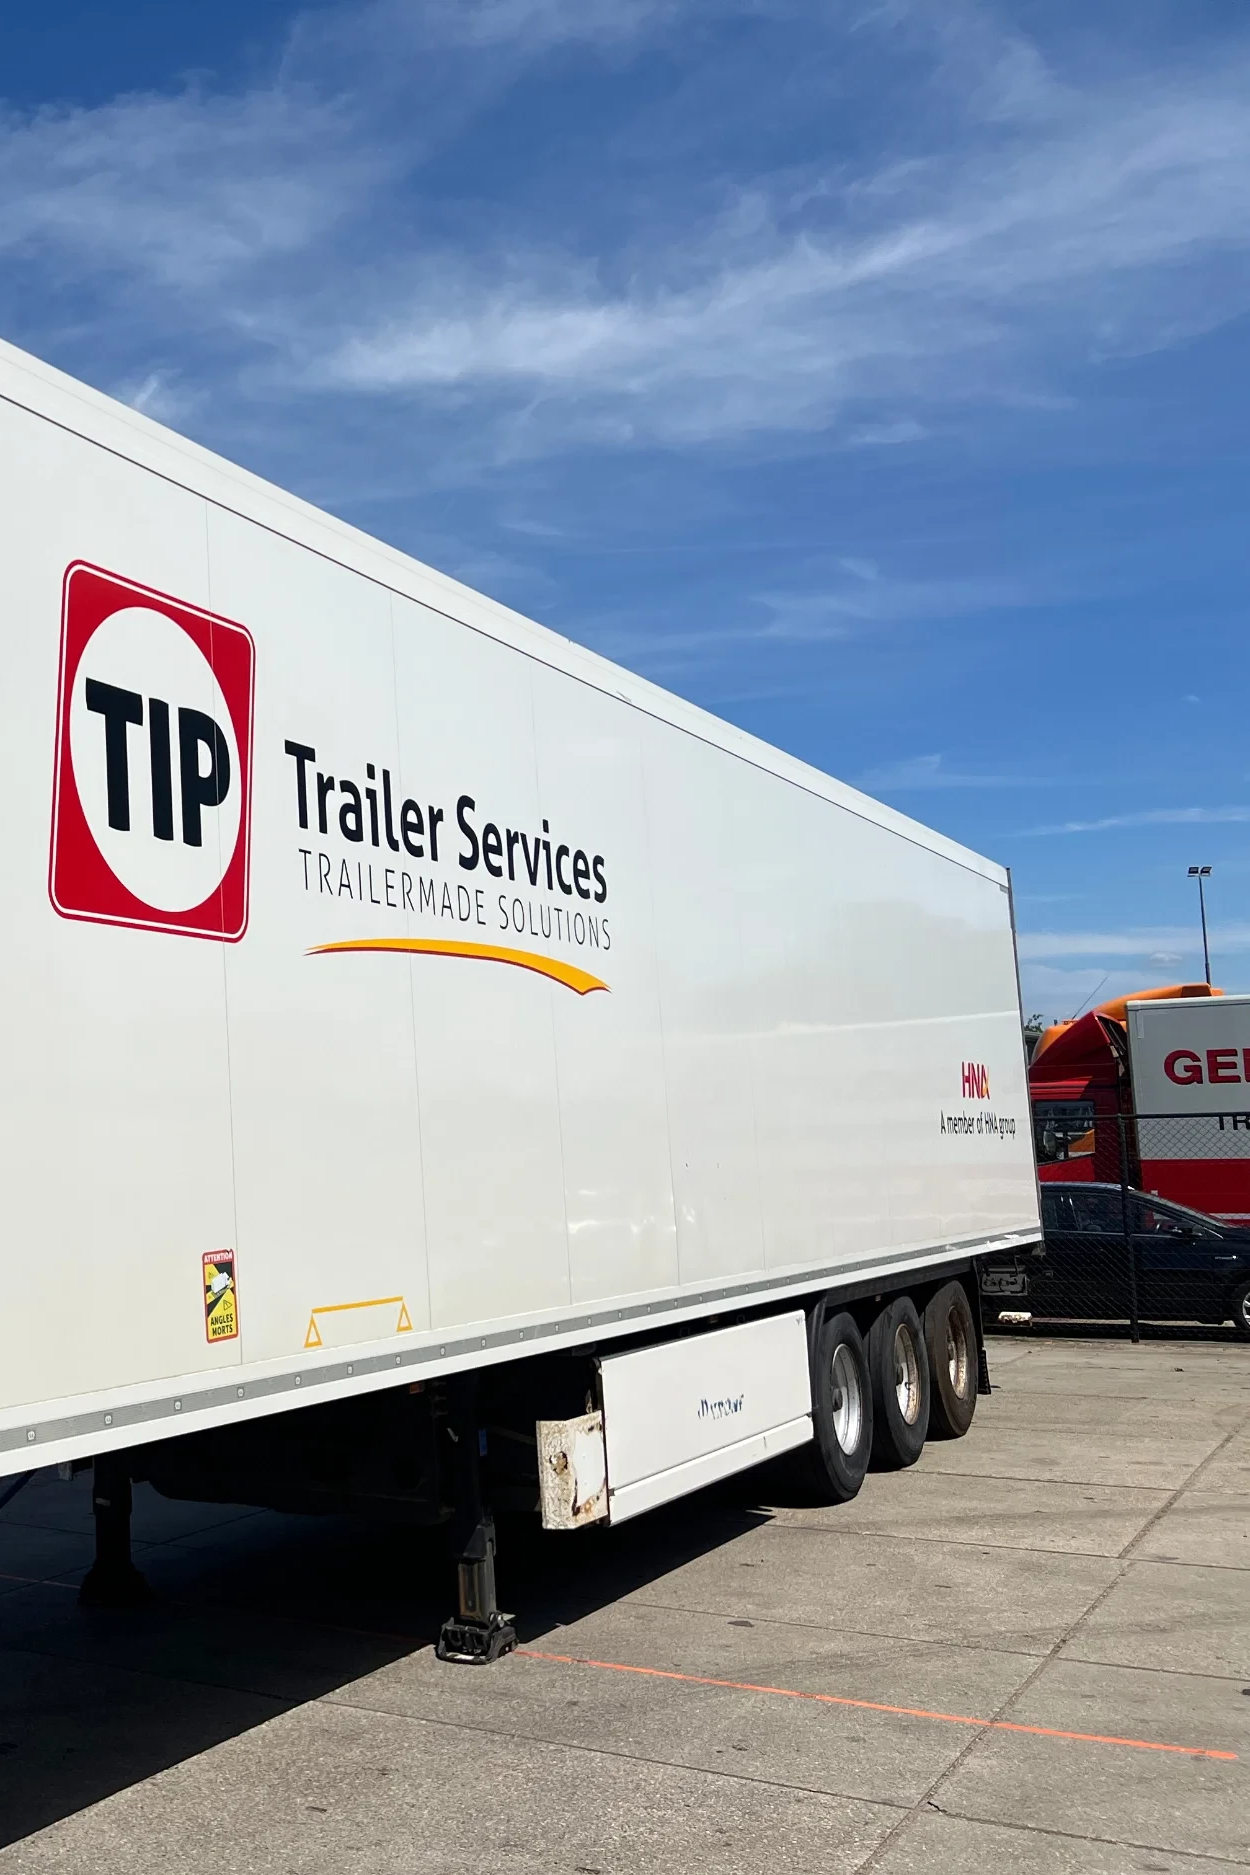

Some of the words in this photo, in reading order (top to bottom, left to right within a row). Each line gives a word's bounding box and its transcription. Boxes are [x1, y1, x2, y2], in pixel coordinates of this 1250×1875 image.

[85, 676, 231, 848] TIP
[284, 739, 446, 862] Trailer
[458, 794, 607, 904] Services
[298, 848, 485, 926] TRAILERMADE
[498, 894, 612, 952] SOLUTIONS
[961, 1061, 991, 1100] HNA
[940, 1109, 947, 1135] A
[947, 1110, 975, 1135] member
[976, 1111, 984, 1135] of
[984, 1111, 999, 1135] HNA
[999, 1118, 1016, 1140] group
[204, 1251, 233, 1263] ATTENTION
[210, 1313, 234, 1326] ANGLES
[212, 1324, 233, 1337] MORTS
